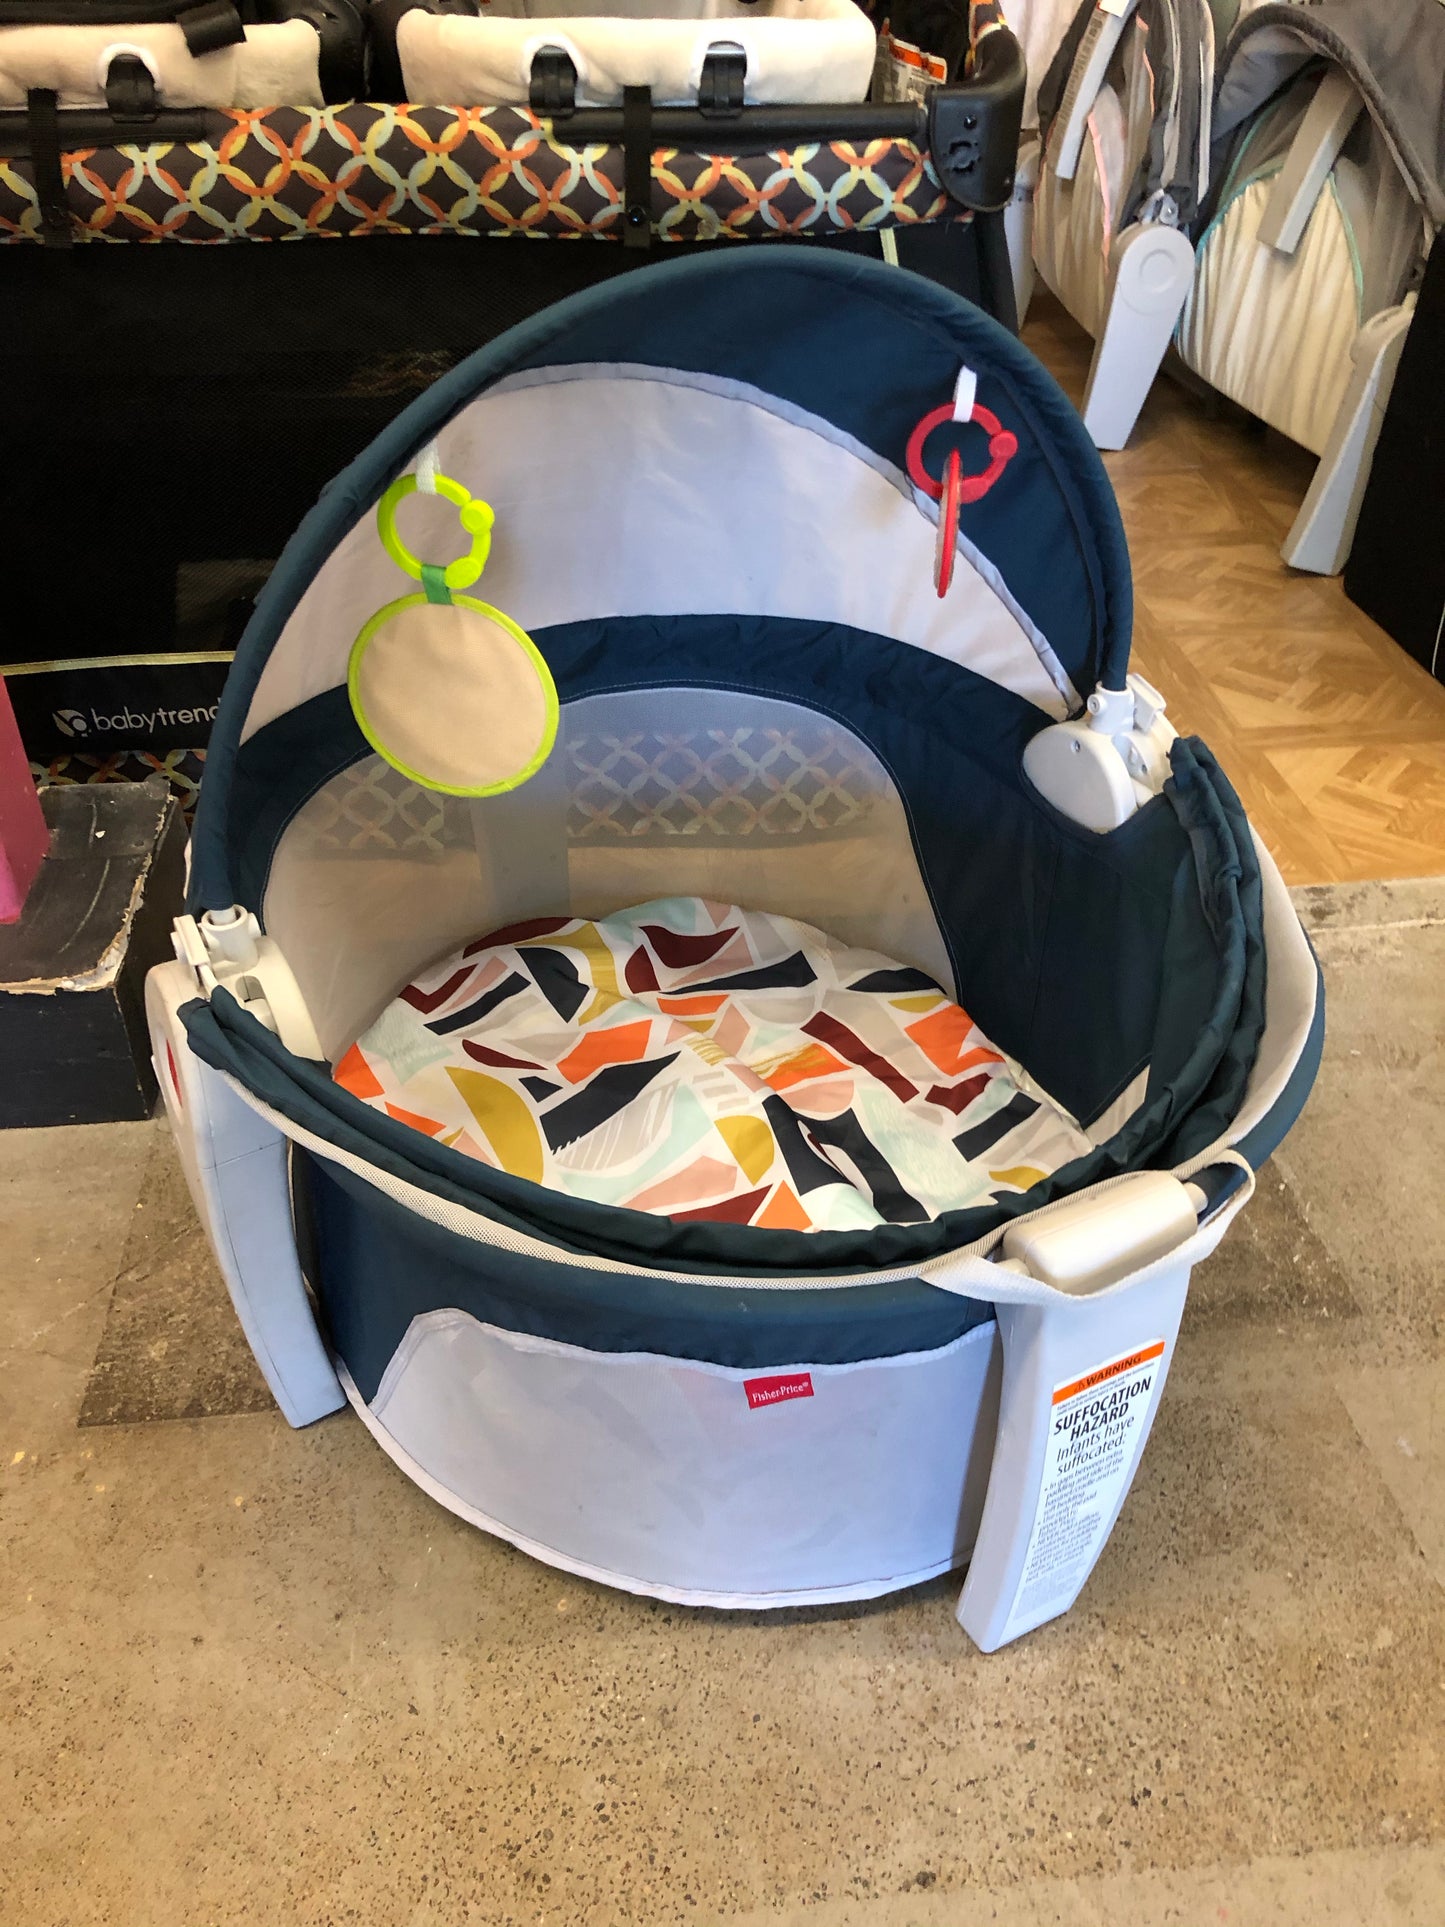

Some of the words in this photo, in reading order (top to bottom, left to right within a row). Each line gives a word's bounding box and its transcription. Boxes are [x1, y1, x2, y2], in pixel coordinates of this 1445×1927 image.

[1086, 1355, 1142, 1387] WARNING
[1054, 1376, 1152, 1436] SUFFOCATION
[1070, 1402, 1129, 1442] HAZARD
[1057, 1433, 1101, 1463] Infants
[1104, 1416, 1135, 1440] have
[1057, 1432, 1127, 1477] suffocated:
